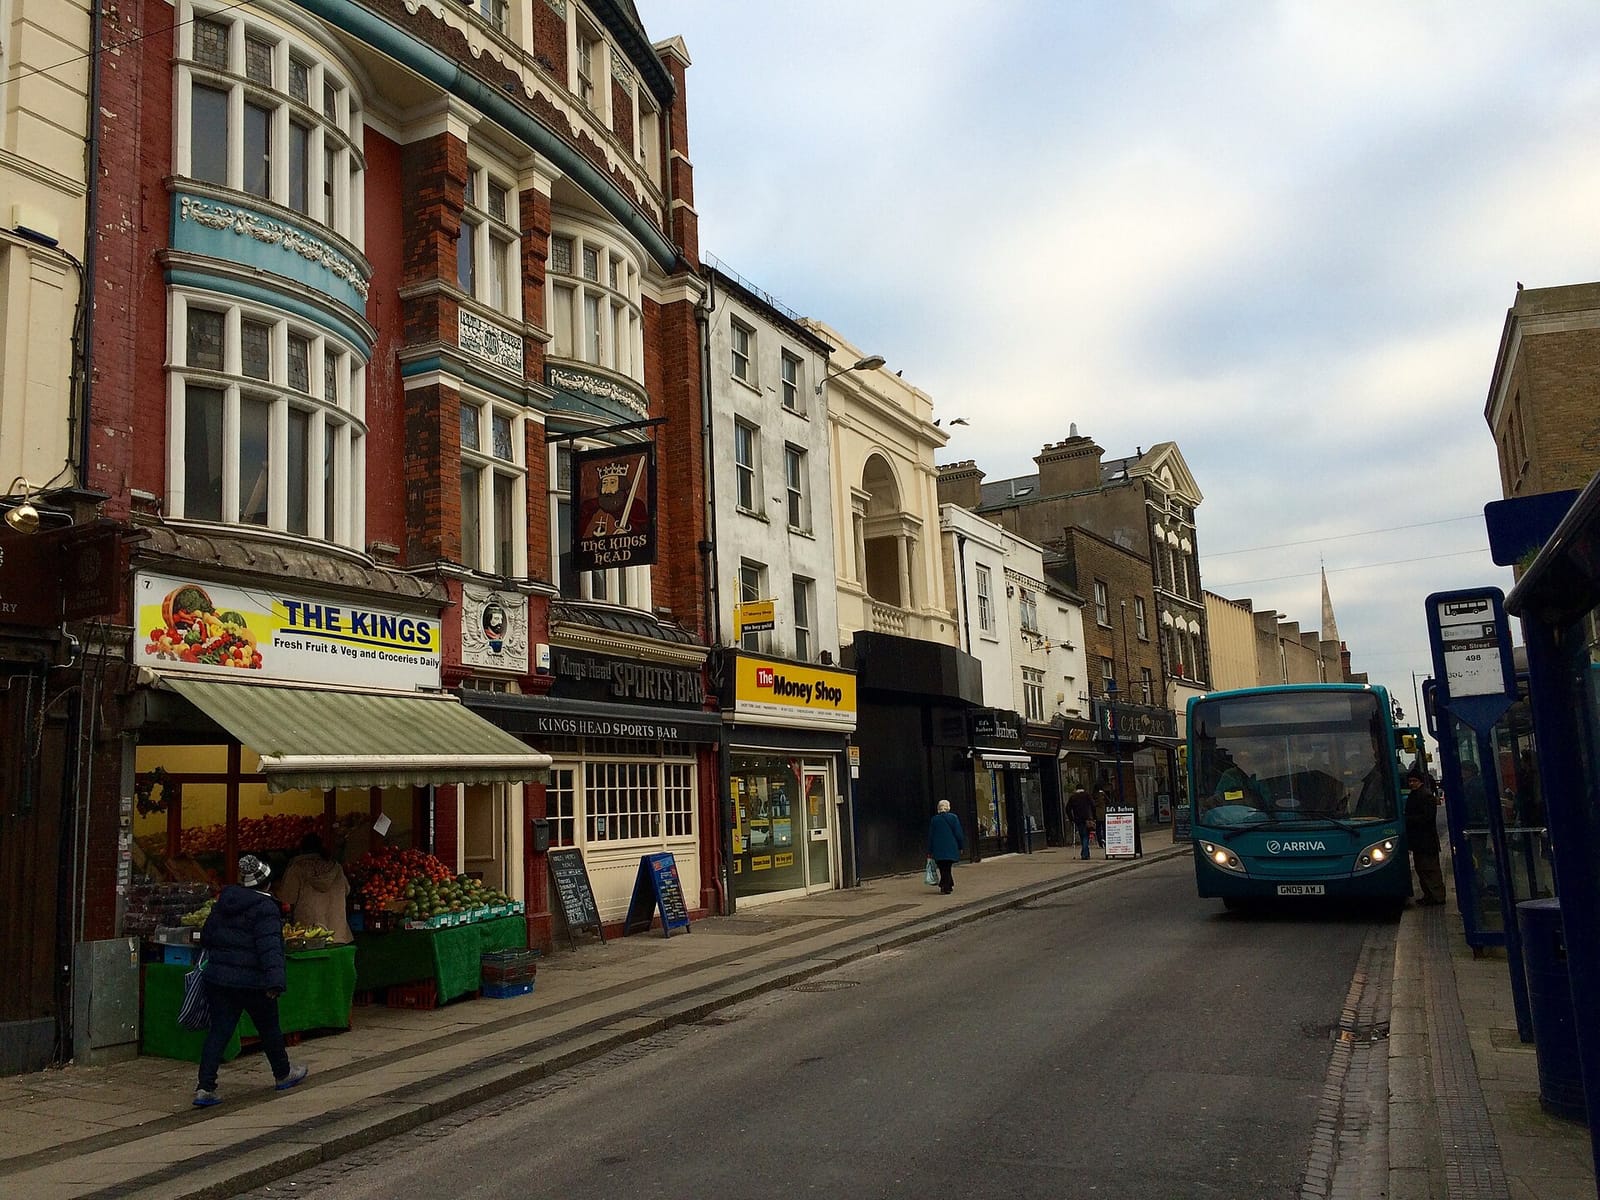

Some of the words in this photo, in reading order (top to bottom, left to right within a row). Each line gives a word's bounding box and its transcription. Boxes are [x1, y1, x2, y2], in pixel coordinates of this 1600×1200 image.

[581, 539, 606, 552] THE
[610, 534, 647, 550] KINGS
[594, 550, 631, 565] HEAD
[144, 581, 151, 589] 7
[283, 600, 342, 632] THE
[351, 611, 431, 645] KINGS
[274, 637, 303, 650] Fresh
[306, 642, 328, 653] Fruit
[330, 645, 338, 654] &
[340, 646, 358, 659] Veg
[360, 649, 377, 659] and
[378, 651, 418, 665] Groceries
[420, 656, 440, 669] Daily
[1451, 644, 1467, 653] King
[1465, 654, 1482, 662] 498
[560, 654, 586, 680] Kings
[588, 657, 611, 680] Head
[613, 661, 673, 700] SPORTS
[676, 670, 705, 704] BAR
[758, 671, 773, 684] The
[773, 675, 813, 704] Money
[815, 681, 842, 707] Shop
[538, 718, 577, 733] KINGS
[579, 720, 611, 735] HEAD
[613, 723, 654, 737] SPORTS
[657, 727, 678, 740] BAR
[1283, 841, 1326, 851] ARRIVA
